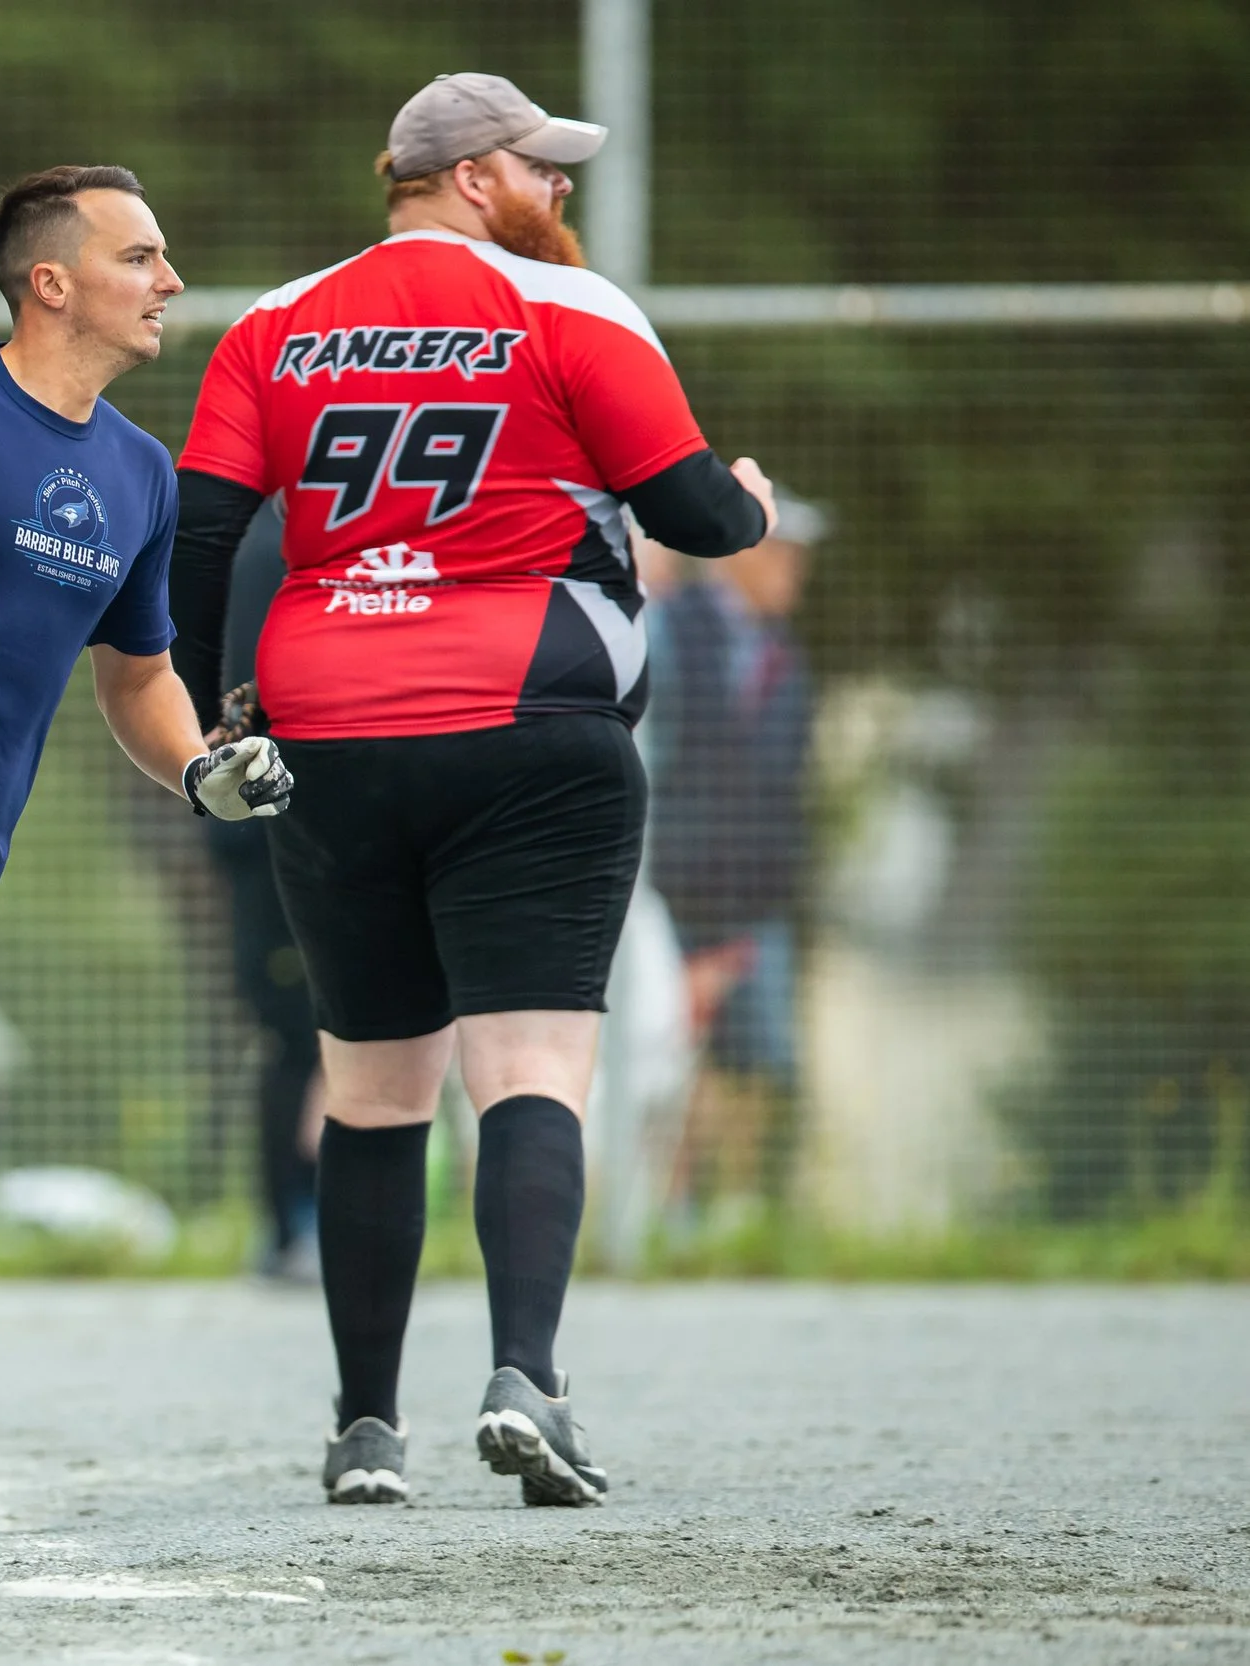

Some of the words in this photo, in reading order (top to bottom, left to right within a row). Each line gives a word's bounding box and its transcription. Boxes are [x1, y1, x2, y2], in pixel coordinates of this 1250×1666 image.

[271, 326, 528, 387] RANGERS
[296, 402, 511, 532] 99
[43, 481, 57, 498] Slow
[60, 477, 81, 489] Pitch
[86, 488, 105, 523] Softball
[15, 526, 62, 559] BARBER
[63, 540, 95, 568] BLUE
[96, 553, 120, 578] JAYS
[37, 563, 76, 582] ESTABLISHED
